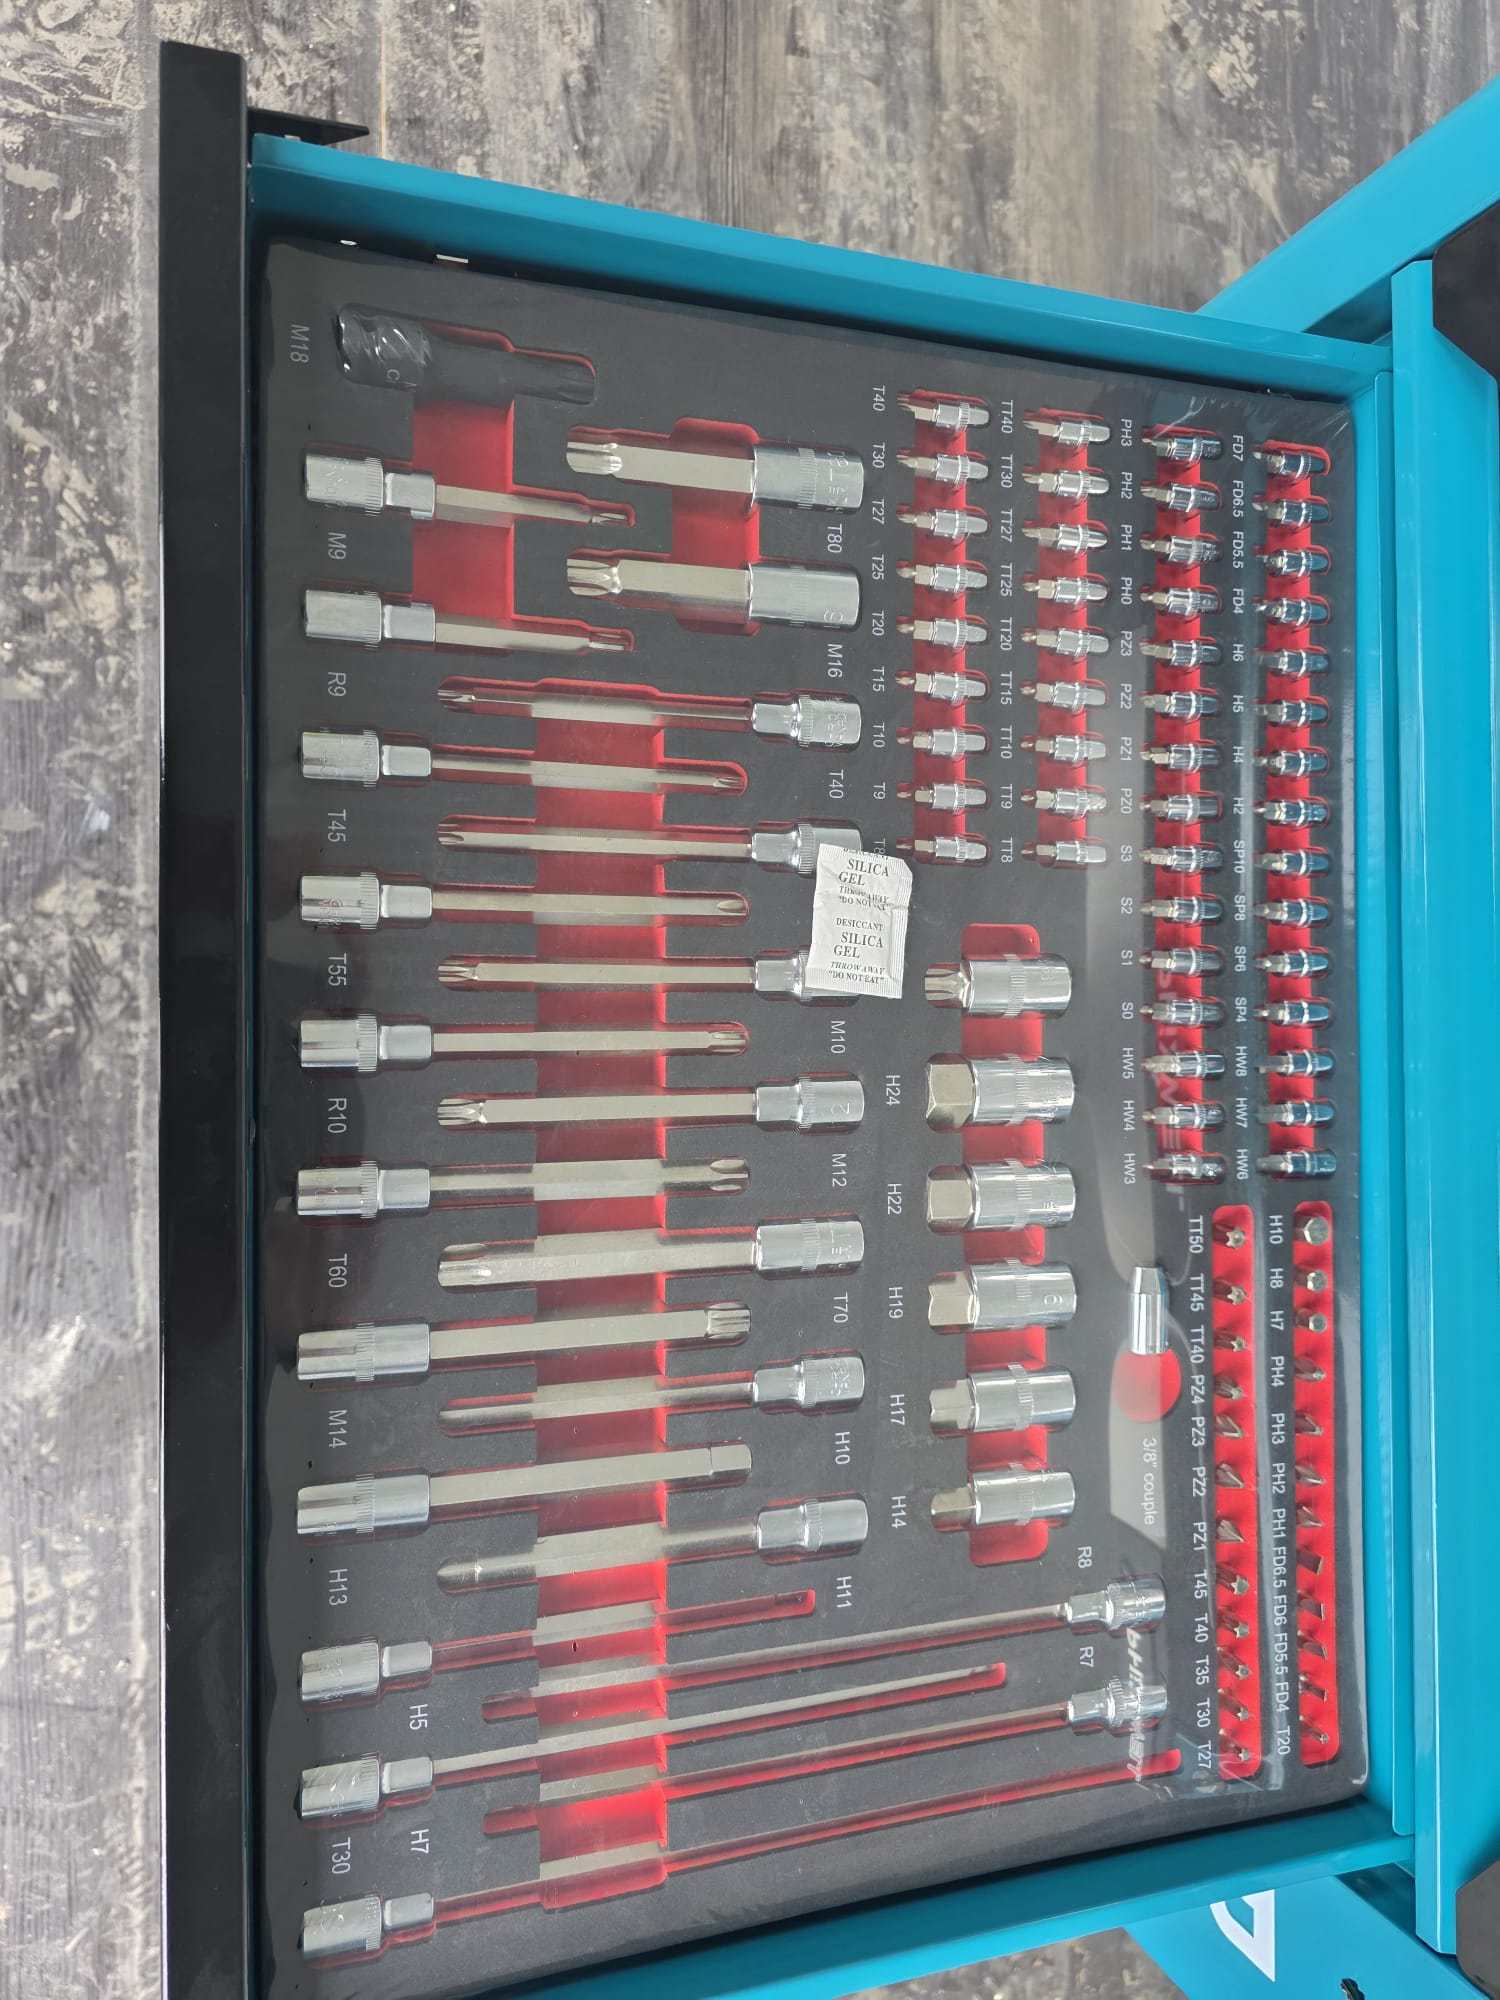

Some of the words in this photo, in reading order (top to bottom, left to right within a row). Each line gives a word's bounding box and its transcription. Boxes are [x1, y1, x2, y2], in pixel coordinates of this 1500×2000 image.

[290, 325, 309, 363] M18
[873, 386, 885, 411] T40
[1001, 400, 1013, 433] TT40
[1121, 419, 1132, 446] PH3
[873, 443, 885, 468] T30
[1233, 435, 1243, 461] FD7
[1001, 454, 1013, 488] TT30
[1121, 472, 1132, 499] PH2
[873, 499, 884, 524] T27
[1233, 480, 1244, 517] FD6.5
[828, 524, 842, 553] T80
[1001, 509, 1012, 542] TT27
[1121, 525, 1132, 550] PH1
[328, 533, 346, 559] M9
[1233, 531, 1243, 568] FD5.5
[872, 555, 884, 579] T25
[1001, 563, 1012, 596] TT25
[1121, 577, 1132, 604] PH0
[1233, 589, 1245, 614] FD4
[872, 611, 884, 635] T20
[1000, 617, 1012, 650] TT20
[1121, 631, 1132, 656] PZ3
[1233, 644, 1244, 661] H6
[828, 644, 842, 677] M16
[328, 672, 346, 696] R9
[873, 667, 884, 691] T15
[1001, 671, 1012, 704] TT15
[1121, 684, 1132, 709] PZ2
[1233, 695, 1244, 712] H5
[873, 722, 885, 747] T10
[1000, 726, 1012, 758] TT10
[1121, 737, 1132, 760] PZ1
[1233, 746, 1244, 763] H4
[829, 769, 844, 798] T40
[874, 783, 885, 799] T9
[1001, 784, 1012, 808] TT9
[1121, 788, 1132, 813] PZ0
[1233, 798, 1245, 814] H2
[328, 809, 346, 842] T45
[1001, 837, 1013, 862] TT8
[1121, 845, 1132, 862] S3
[1234, 840, 1246, 873] SP10
[839, 871, 866, 886] GEL
[847, 858, 889, 877] SILICA
[1121, 898, 1132, 914] S2
[1234, 895, 1246, 920] SP8
[836, 917, 884, 932] DESICCANT
[834, 944, 861, 959] GEL
[841, 931, 884, 948] SILICA
[328, 953, 346, 985] T55
[831, 961, 862, 972] THROW
[862, 965, 886, 975] AWAY
[1121, 950, 1133, 965] S1
[1235, 946, 1246, 971] SP6
[846, 972, 863, 982] NOT
[1122, 1002, 1133, 1019] S0
[1235, 997, 1246, 1022] SP4
[831, 1021, 845, 1053] M10
[1123, 1048, 1134, 1079] HW5
[1236, 1046, 1247, 1076] HW8
[886, 1075, 900, 1105] H24
[328, 1098, 346, 1133] R10
[1123, 1101, 1135, 1130] HW4
[1236, 1098, 1248, 1127] HW7
[832, 1154, 847, 1187] M12
[1124, 1153, 1135, 1184] HW3
[1237, 1149, 1248, 1179] HW6
[888, 1184, 902, 1214] H22
[1189, 1215, 1203, 1253] TT50
[1269, 1215, 1283, 1244] H10
[329, 1254, 347, 1287] T60
[1270, 1268, 1283, 1288] H8
[889, 1287, 903, 1318] H19
[1190, 1273, 1204, 1311] TT45
[834, 1292, 848, 1322] T70
[1270, 1311, 1284, 1330] H7
[1190, 1325, 1204, 1363] TT40
[1271, 1356, 1284, 1387] PH4
[1191, 1375, 1205, 1404] PZ4
[890, 1394, 905, 1425] H17
[329, 1410, 347, 1448] M14
[1192, 1417, 1205, 1446] PZ3
[1272, 1413, 1285, 1444] PH3
[835, 1432, 850, 1464] H10
[1192, 1467, 1207, 1496] PZ2
[1272, 1463, 1285, 1493] PH2
[892, 1496, 906, 1528] H14
[1141, 1473, 1157, 1525] couple
[1194, 1522, 1207, 1550] PZ1
[1273, 1509, 1286, 1537] PH1
[1078, 1546, 1092, 1568] R8
[1273, 1547, 1286, 1588] FD6.5
[329, 1569, 347, 1605] H13
[837, 1576, 851, 1607] H11
[1194, 1569, 1208, 1598] T45
[1274, 1595, 1287, 1626] FD6
[1195, 1613, 1208, 1642] T40
[1080, 1647, 1094, 1667] R7
[1274, 1633, 1288, 1674] FD5.5
[1196, 1655, 1209, 1685] T35
[1275, 1682, 1289, 1712] FD4
[410, 1704, 428, 1729] H5
[1197, 1698, 1210, 1727] T30
[1198, 1740, 1211, 1768] T27
[1276, 1726, 1291, 1755] T20
[332, 1837, 350, 1874] T30
[411, 1829, 429, 1853] H7
